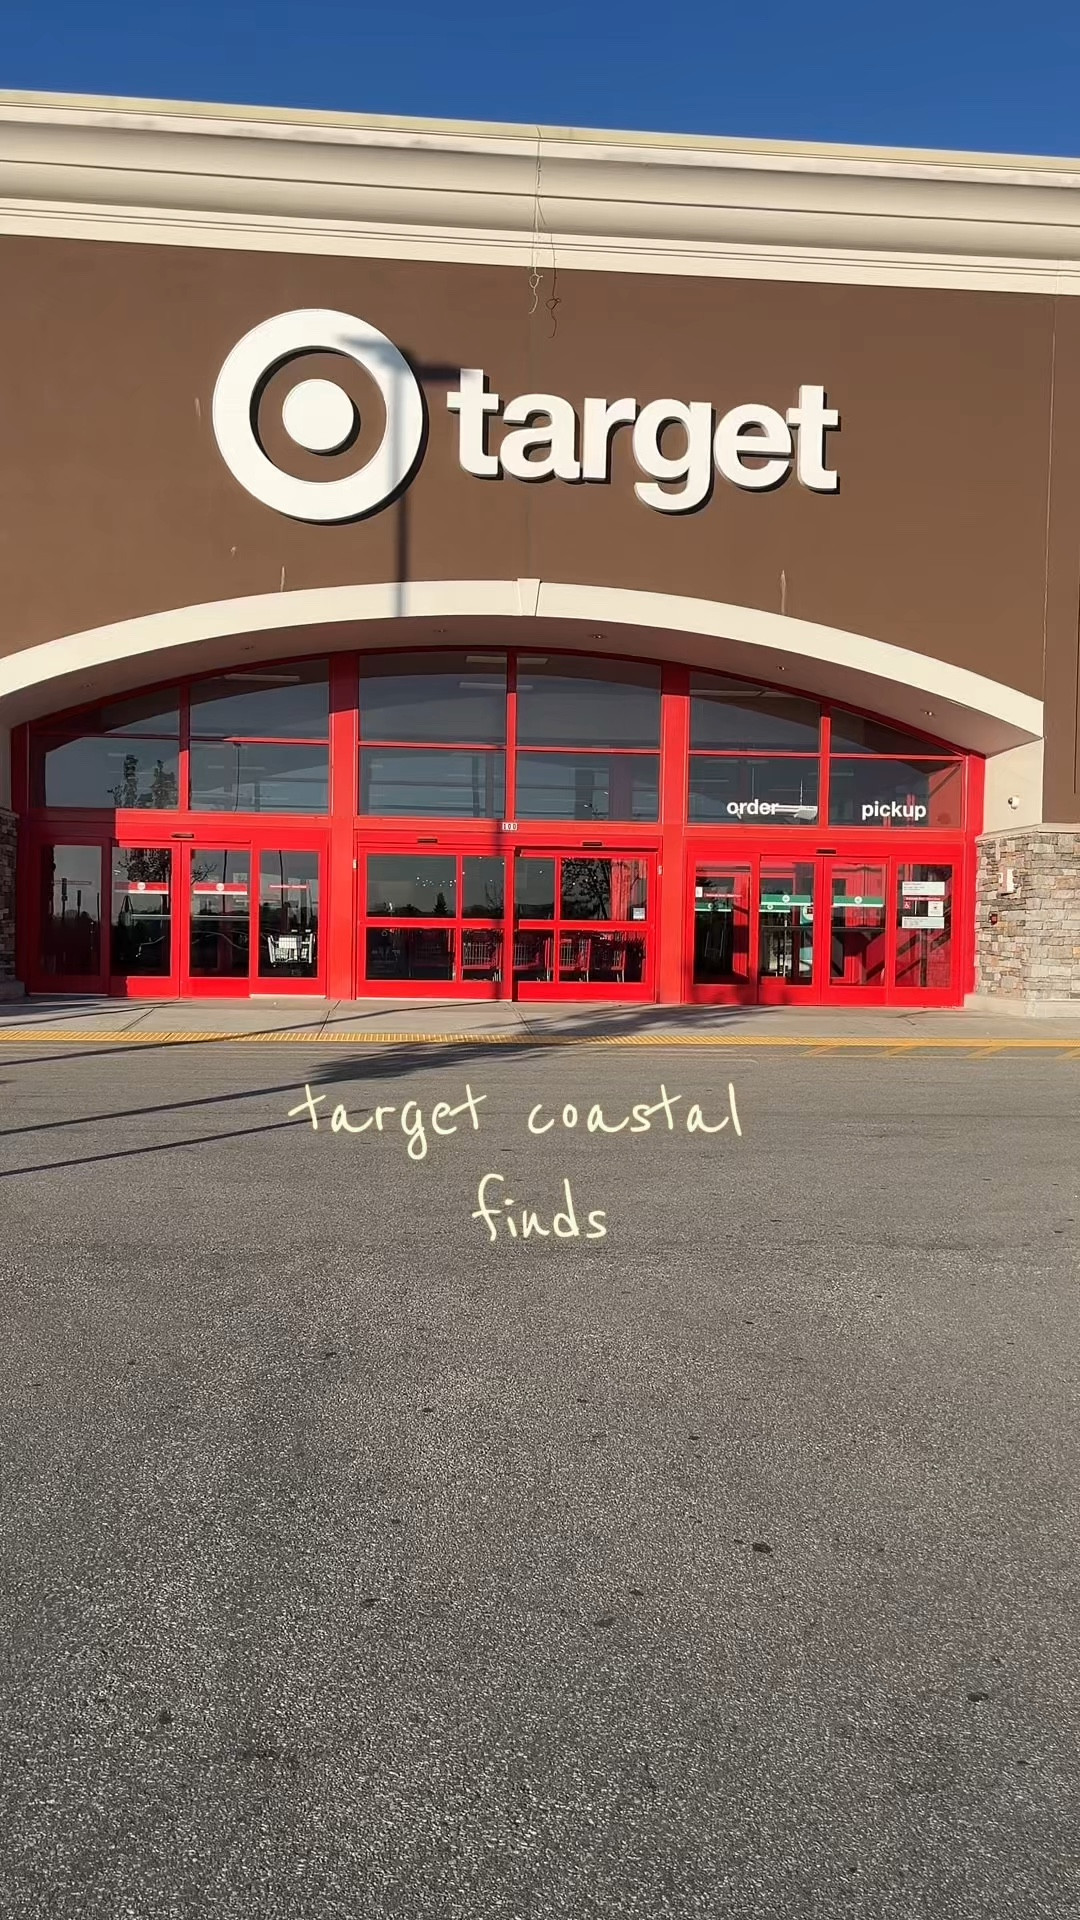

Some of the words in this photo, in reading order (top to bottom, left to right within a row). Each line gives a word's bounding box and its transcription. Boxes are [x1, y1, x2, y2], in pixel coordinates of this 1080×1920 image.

[446, 368, 839, 513] target
[726, 798, 779, 816] order
[862, 800, 927, 821] pickup
